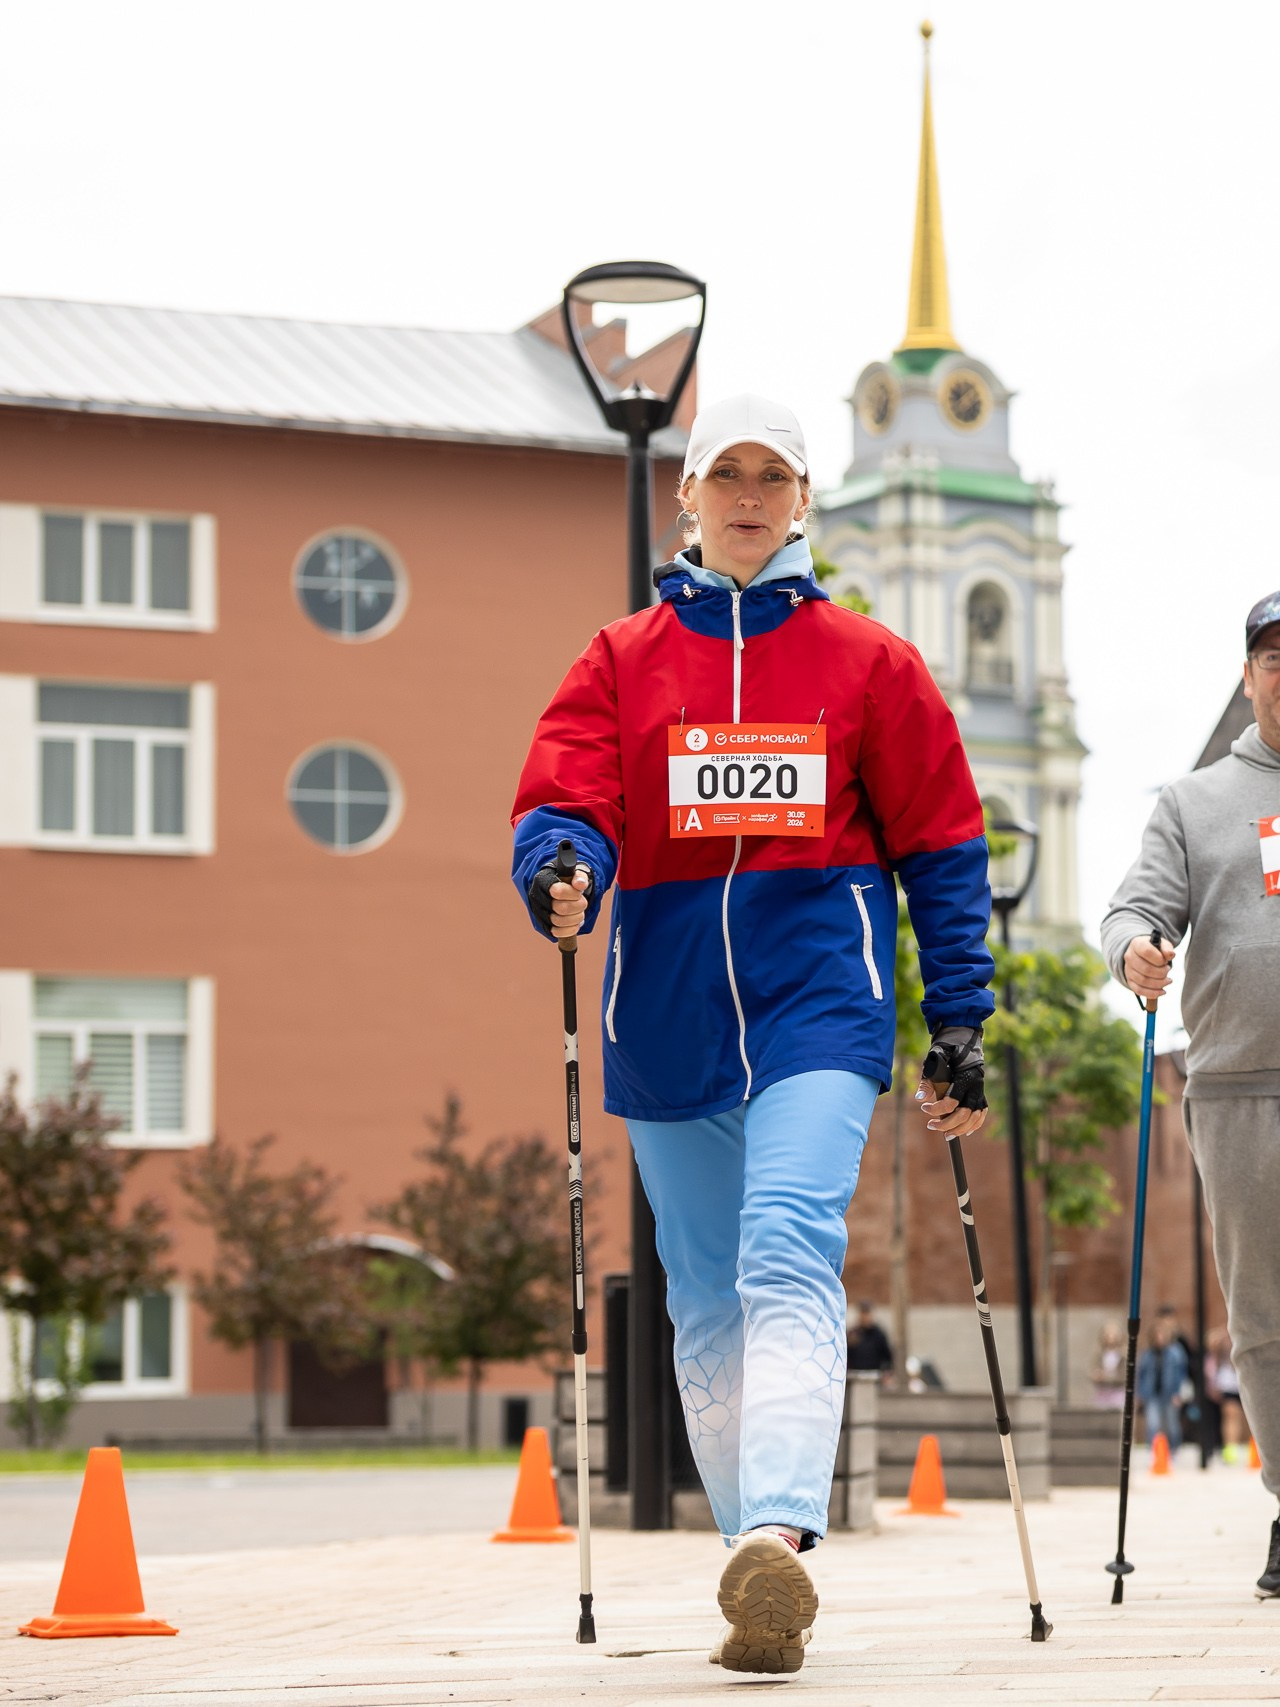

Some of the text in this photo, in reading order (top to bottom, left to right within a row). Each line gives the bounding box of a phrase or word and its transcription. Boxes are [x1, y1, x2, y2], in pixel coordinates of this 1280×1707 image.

[693, 733, 700, 743] 2
[729, 732, 808, 744] СБЕР МОБАЙЛ
[697, 763, 798, 800] 0020
[787, 819, 804, 827] 2026
[573, 1201, 583, 1272] NORDIC WALKING POLE
